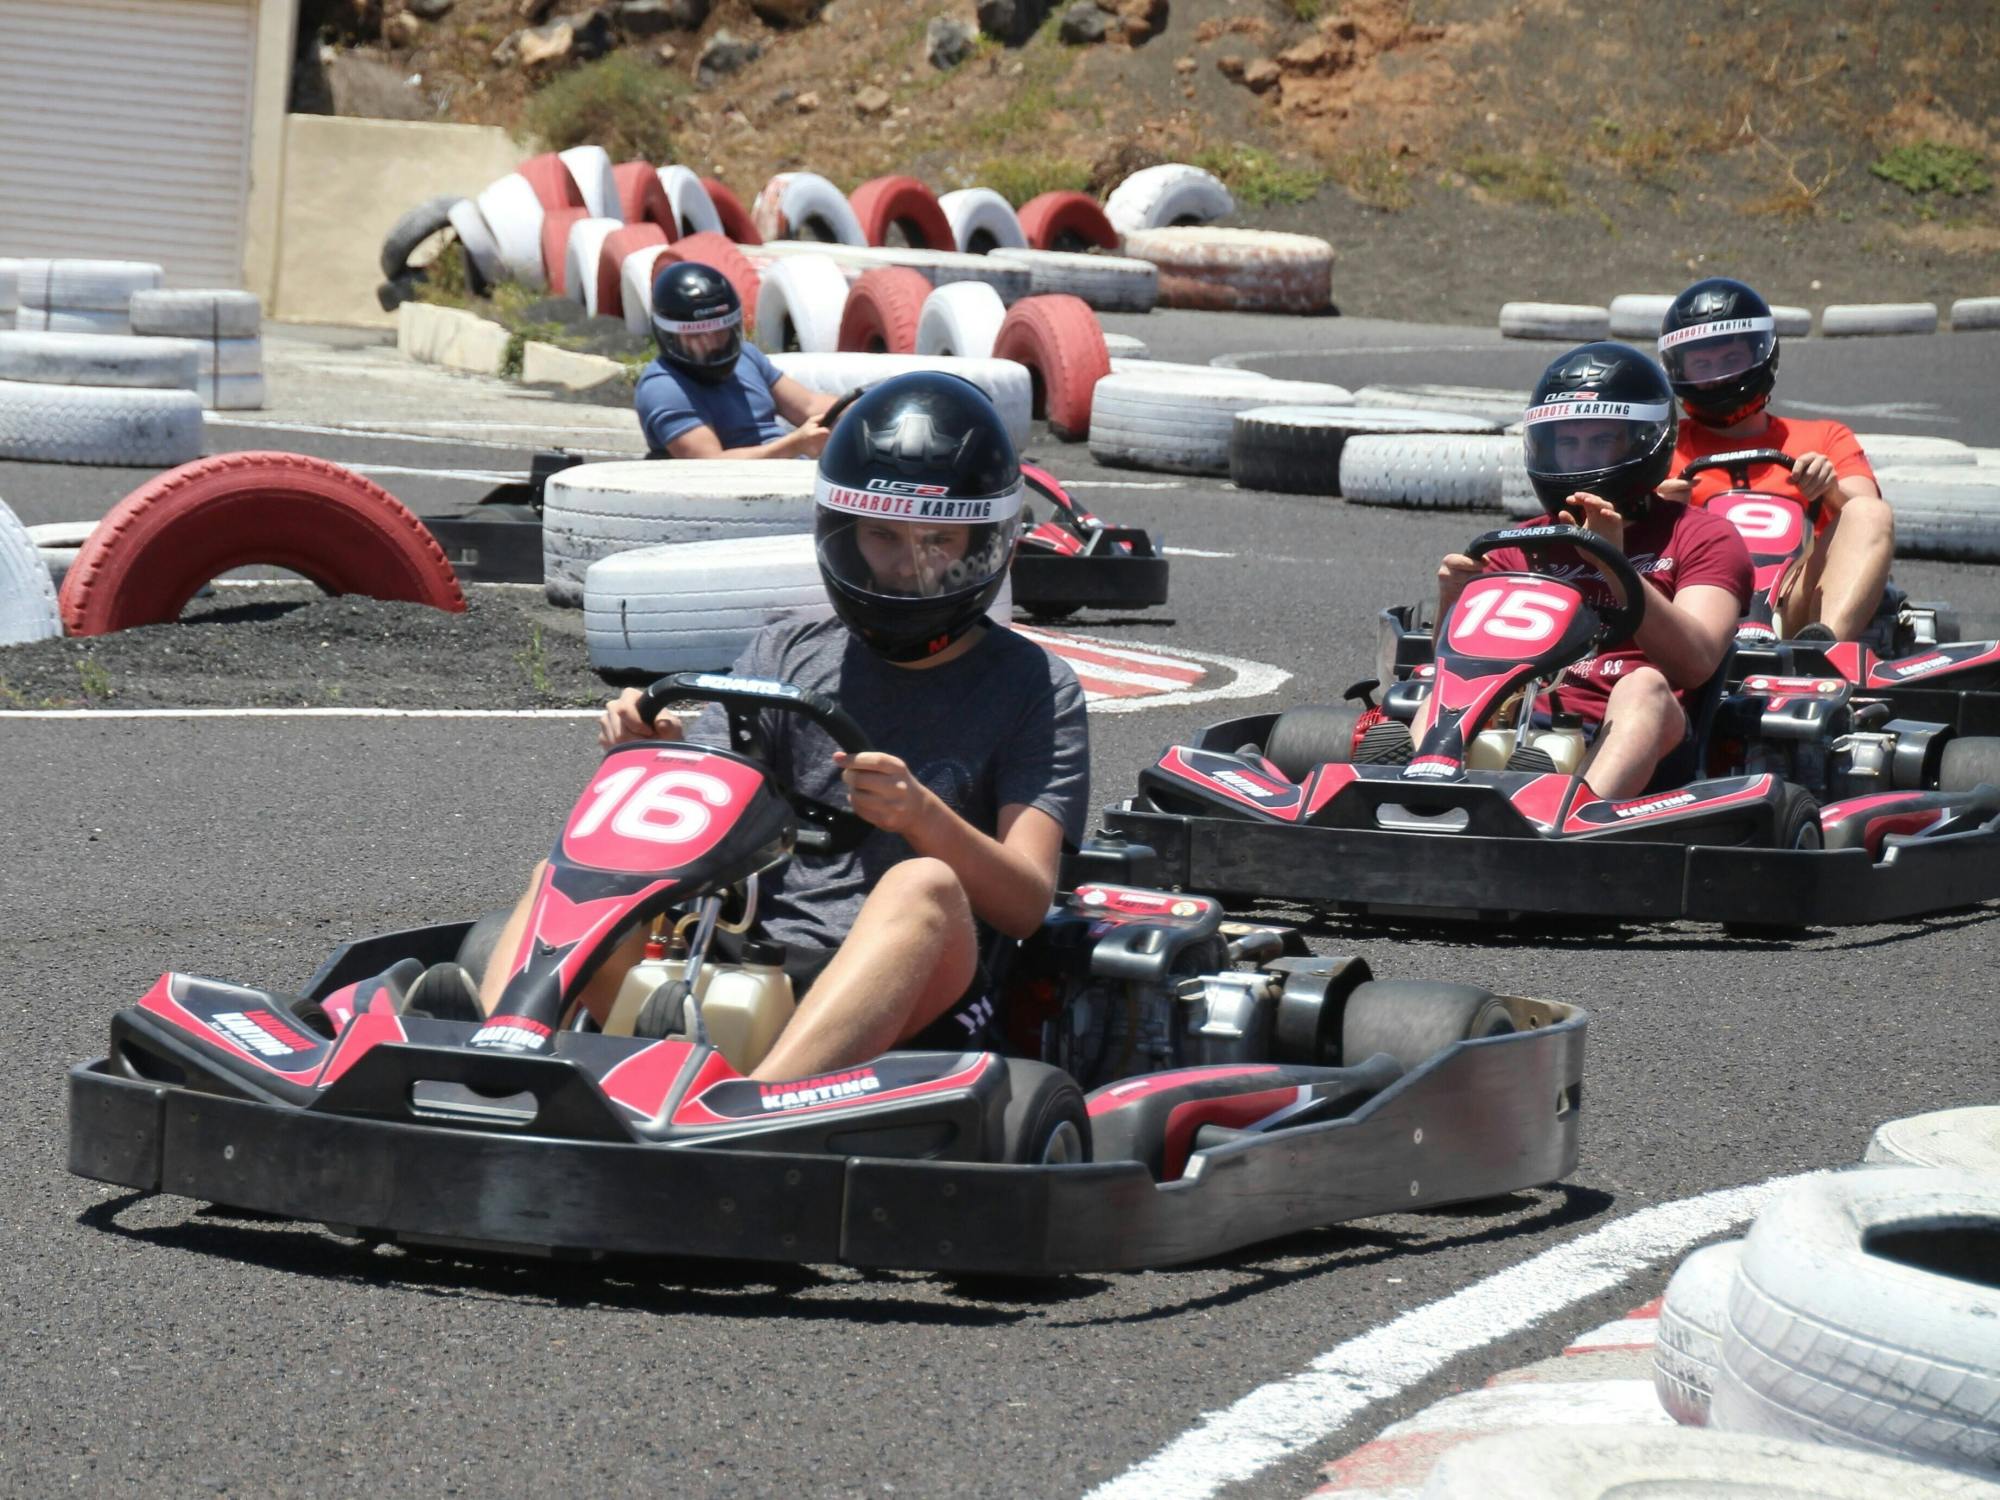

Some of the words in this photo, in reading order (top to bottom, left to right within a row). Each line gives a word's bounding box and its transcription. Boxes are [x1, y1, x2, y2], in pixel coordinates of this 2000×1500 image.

[1712, 318, 1754, 332] KARTING
[1574, 404, 1631, 416] KARTING
[828, 486, 914, 514] LANZAROTE
[919, 500, 992, 517] KARTING
[866, 478, 950, 497] LS2
[1498, 526, 1556, 540] BIZKARTS
[1726, 503, 1792, 539] 9
[1453, 588, 1569, 641] 15
[570, 766, 732, 844] 16
[1615, 793, 1697, 818] KARTING
[761, 1076, 880, 1110] KARTING
